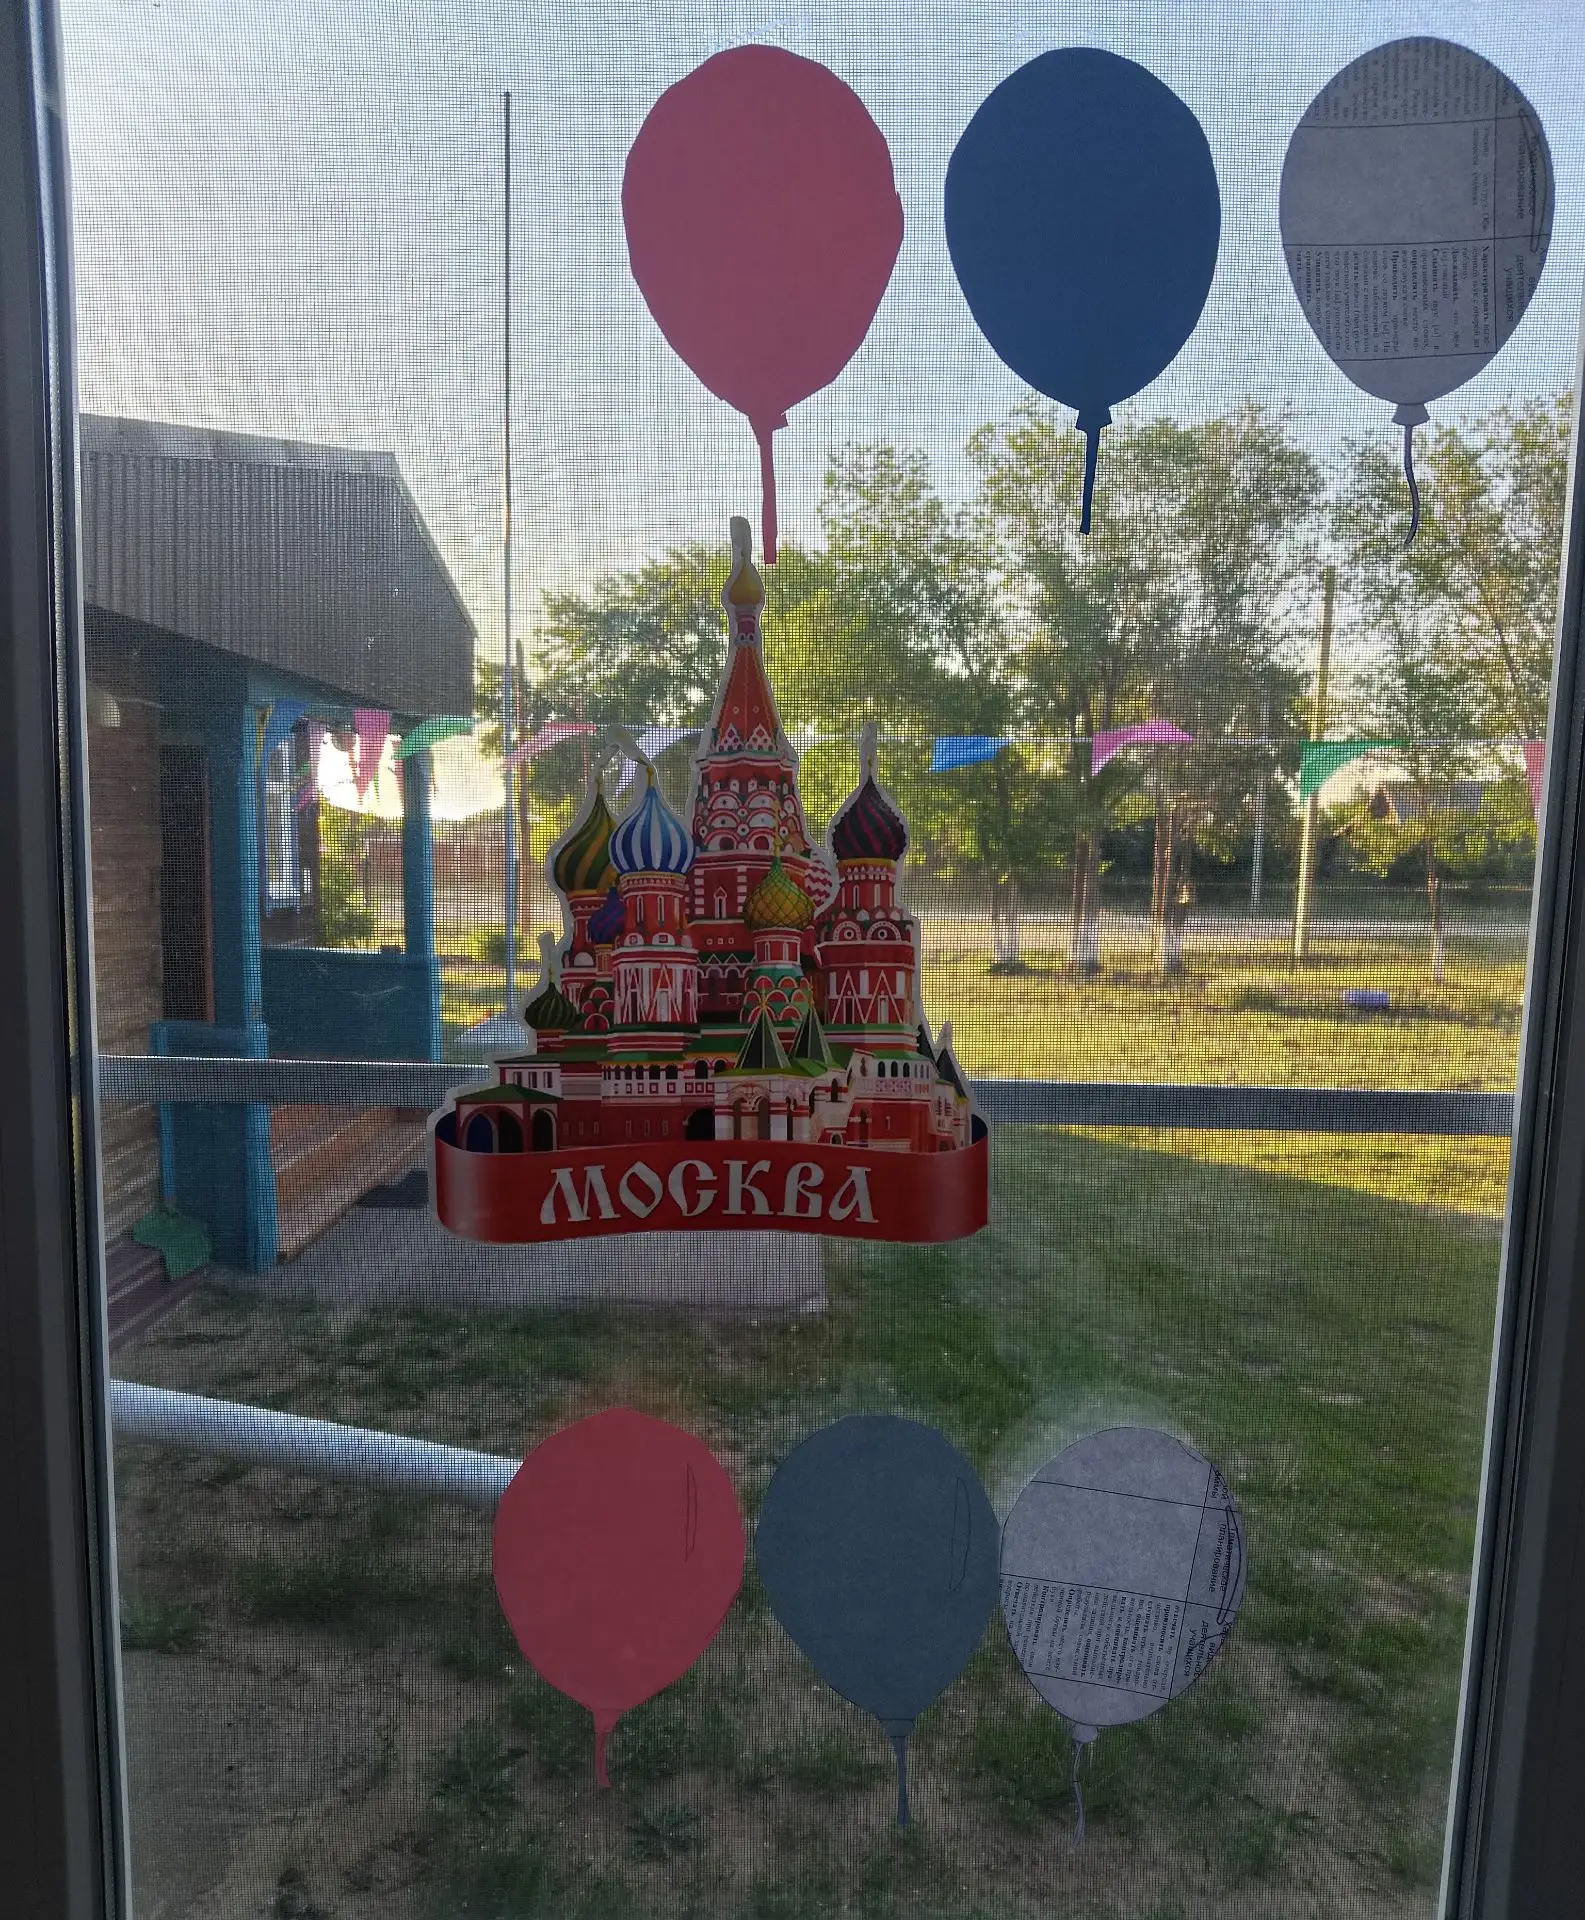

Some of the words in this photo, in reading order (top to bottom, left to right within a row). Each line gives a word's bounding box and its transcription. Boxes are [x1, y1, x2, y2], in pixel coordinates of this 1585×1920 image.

[1503, 267, 1513, 321] учащихся
[540, 1160, 879, 1224] МОСКВА
[1209, 1523, 1227, 1593] планирование
[1183, 1629, 1196, 1676] учащихся
